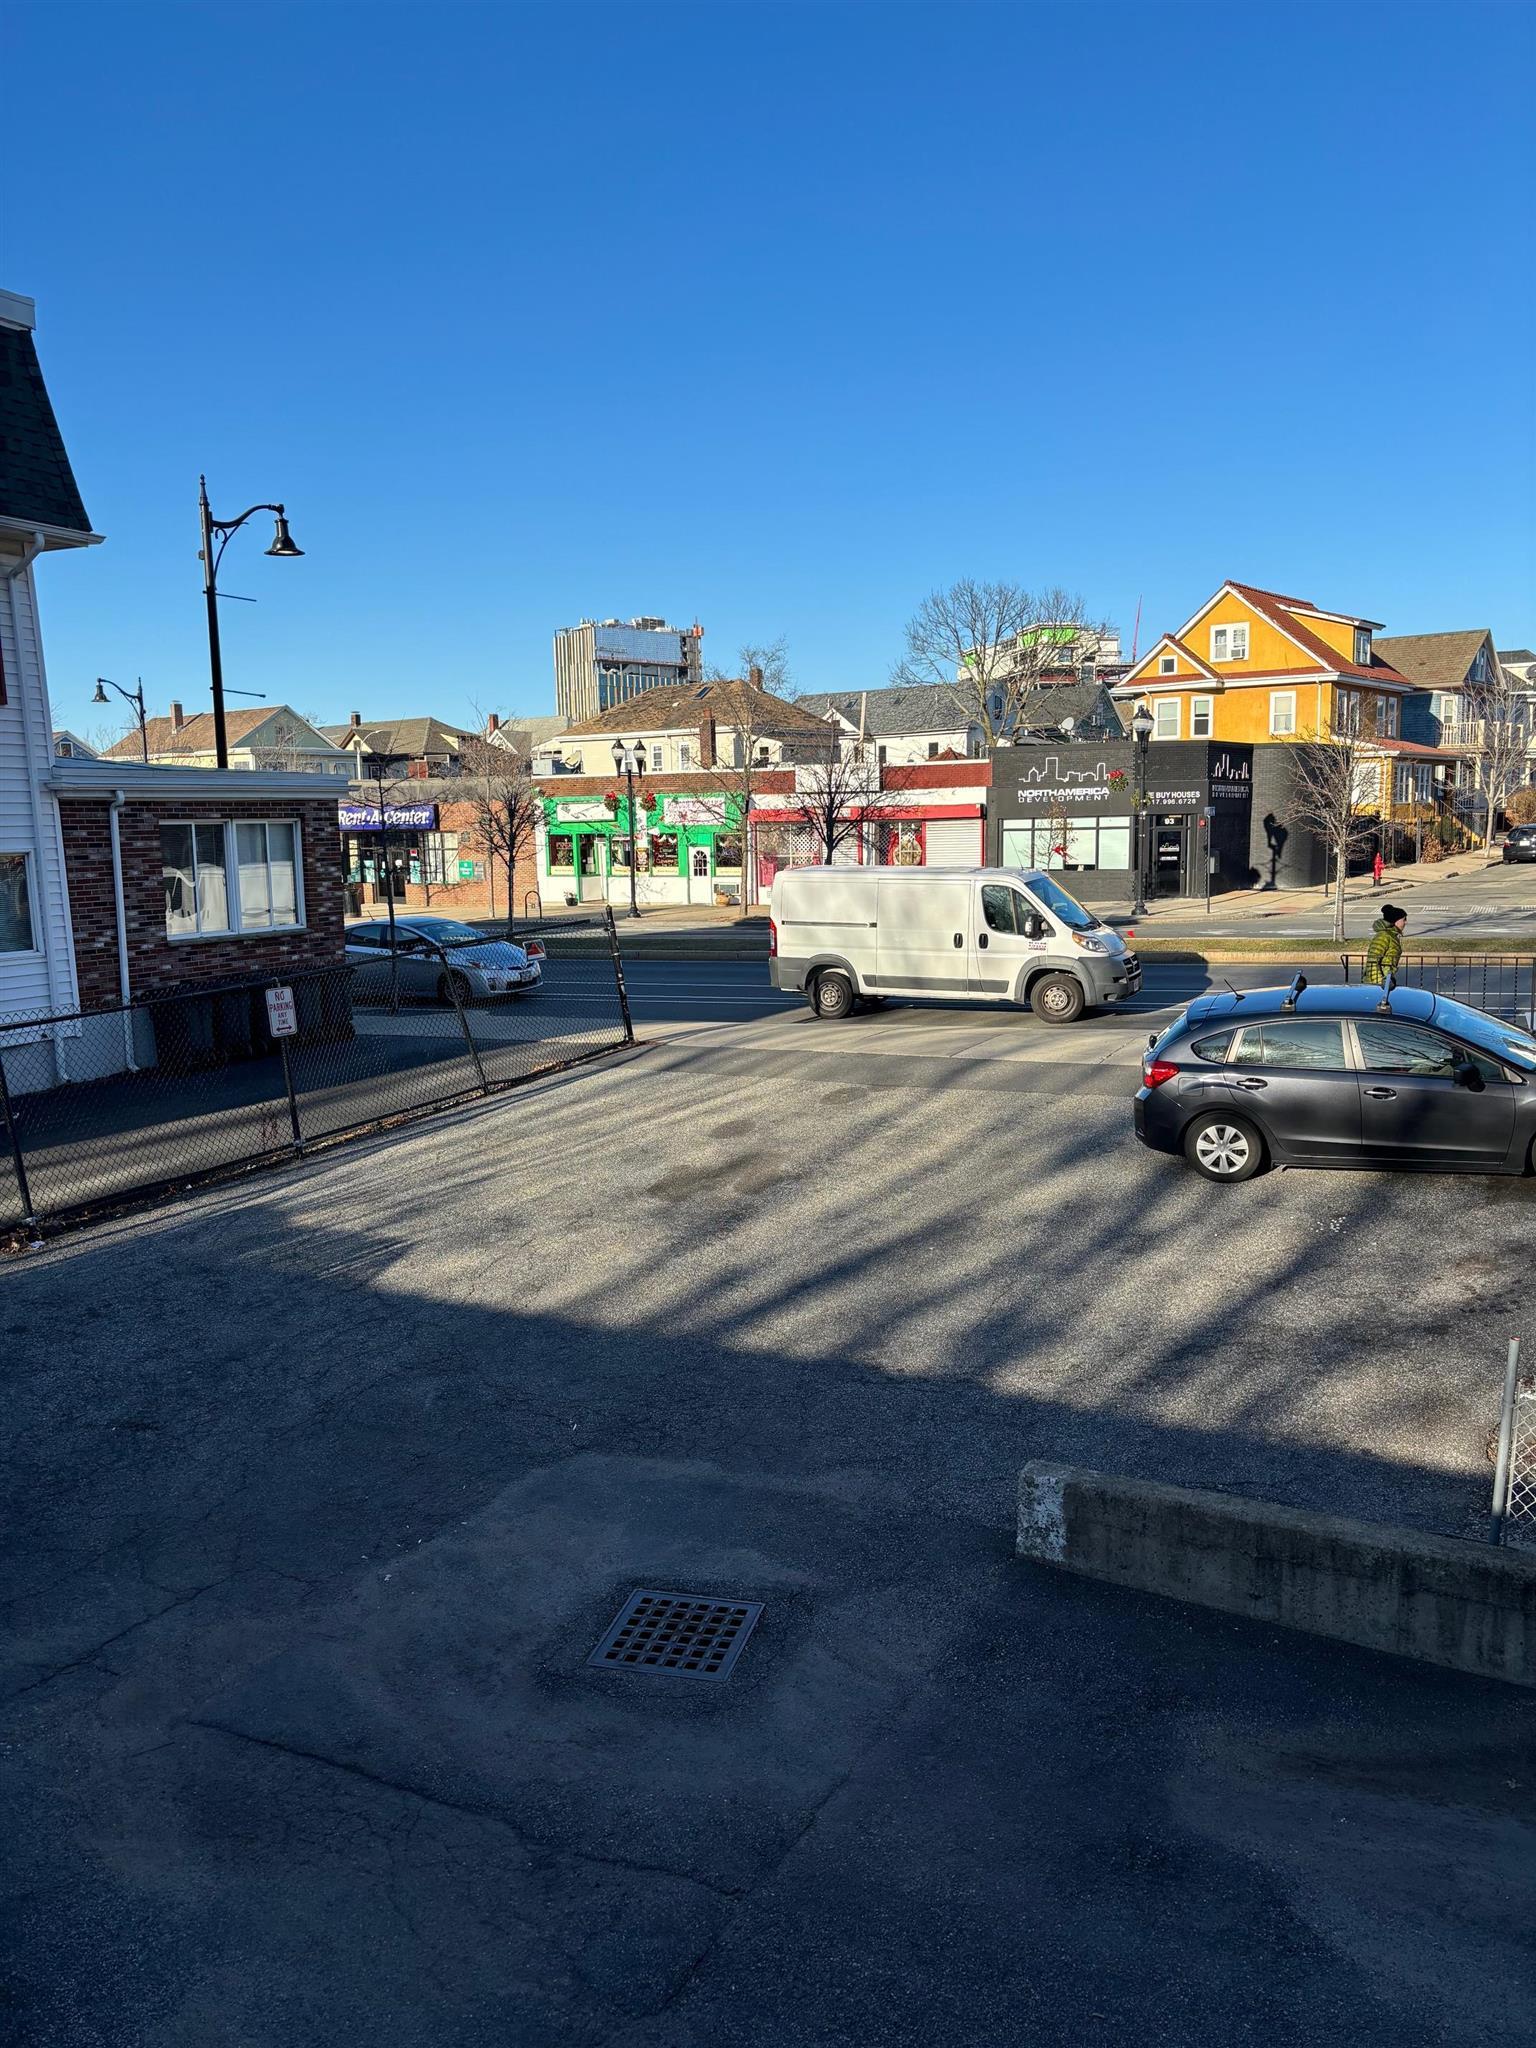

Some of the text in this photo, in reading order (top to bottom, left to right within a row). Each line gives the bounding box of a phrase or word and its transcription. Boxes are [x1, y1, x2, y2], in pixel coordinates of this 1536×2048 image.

[1018, 787, 1110, 797] NORTHAMERICA
[1019, 795, 1108, 803] DEVELOPMENT
[275, 991, 285, 1001] NO
[269, 1002, 293, 1012] PARKING
